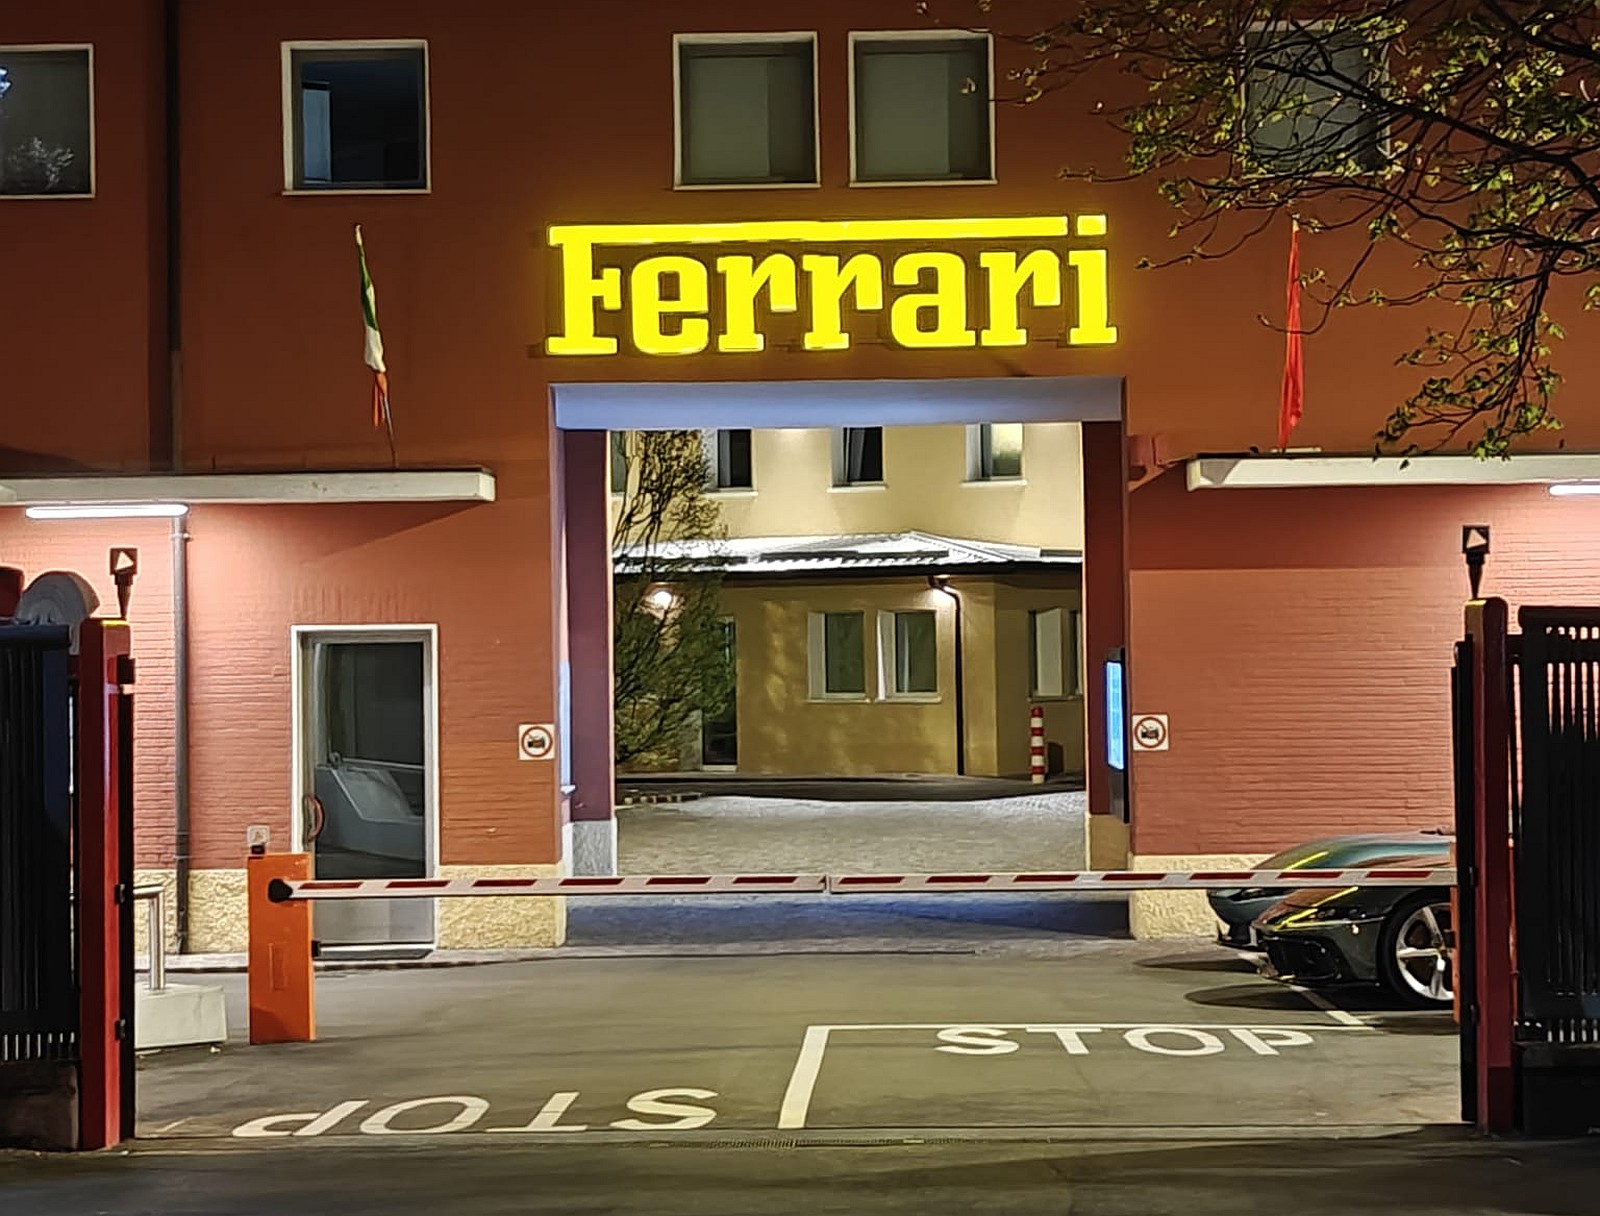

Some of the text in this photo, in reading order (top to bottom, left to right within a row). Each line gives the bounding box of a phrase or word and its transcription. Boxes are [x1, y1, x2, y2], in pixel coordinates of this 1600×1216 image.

[546, 214, 1118, 356] Ferrari
[935, 1026, 1314, 1056] STOP
[232, 1088, 719, 1137] STOP
